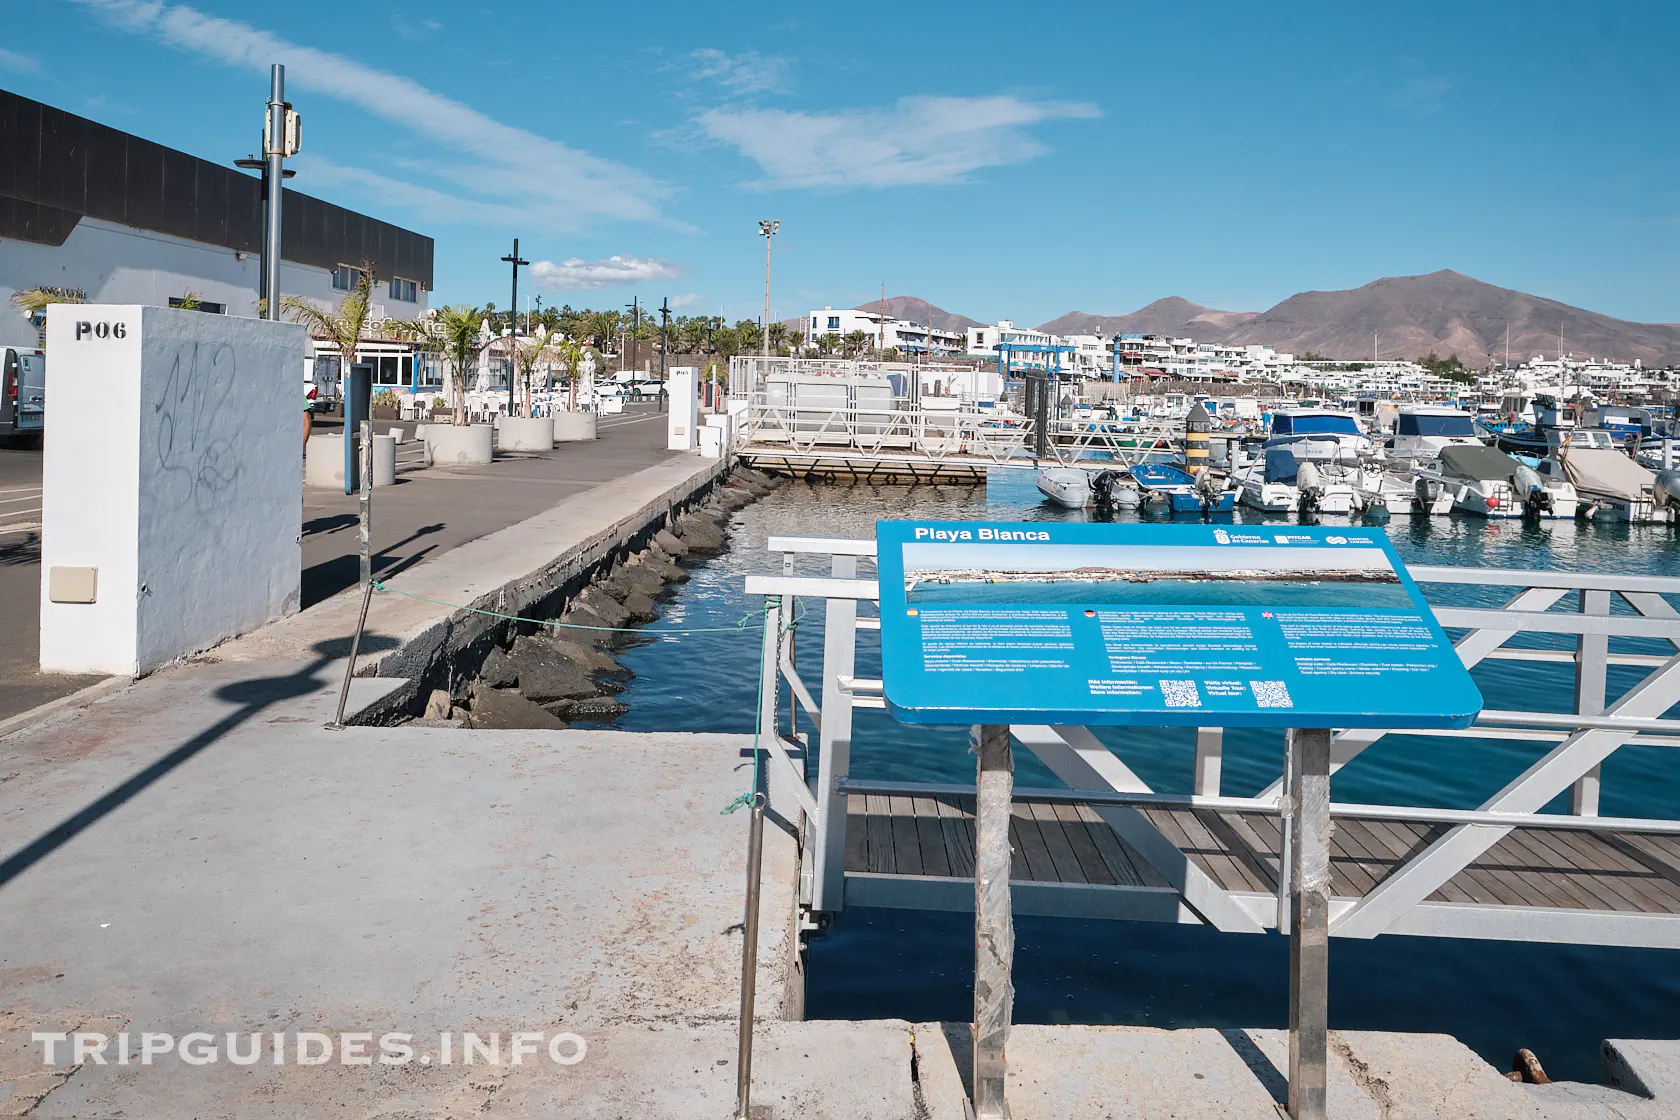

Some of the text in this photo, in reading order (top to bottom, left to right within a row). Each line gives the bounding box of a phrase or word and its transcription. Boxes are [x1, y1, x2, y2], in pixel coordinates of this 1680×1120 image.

[76, 320, 127, 341] P06
[914, 527, 1051, 543] Playa Blanca
